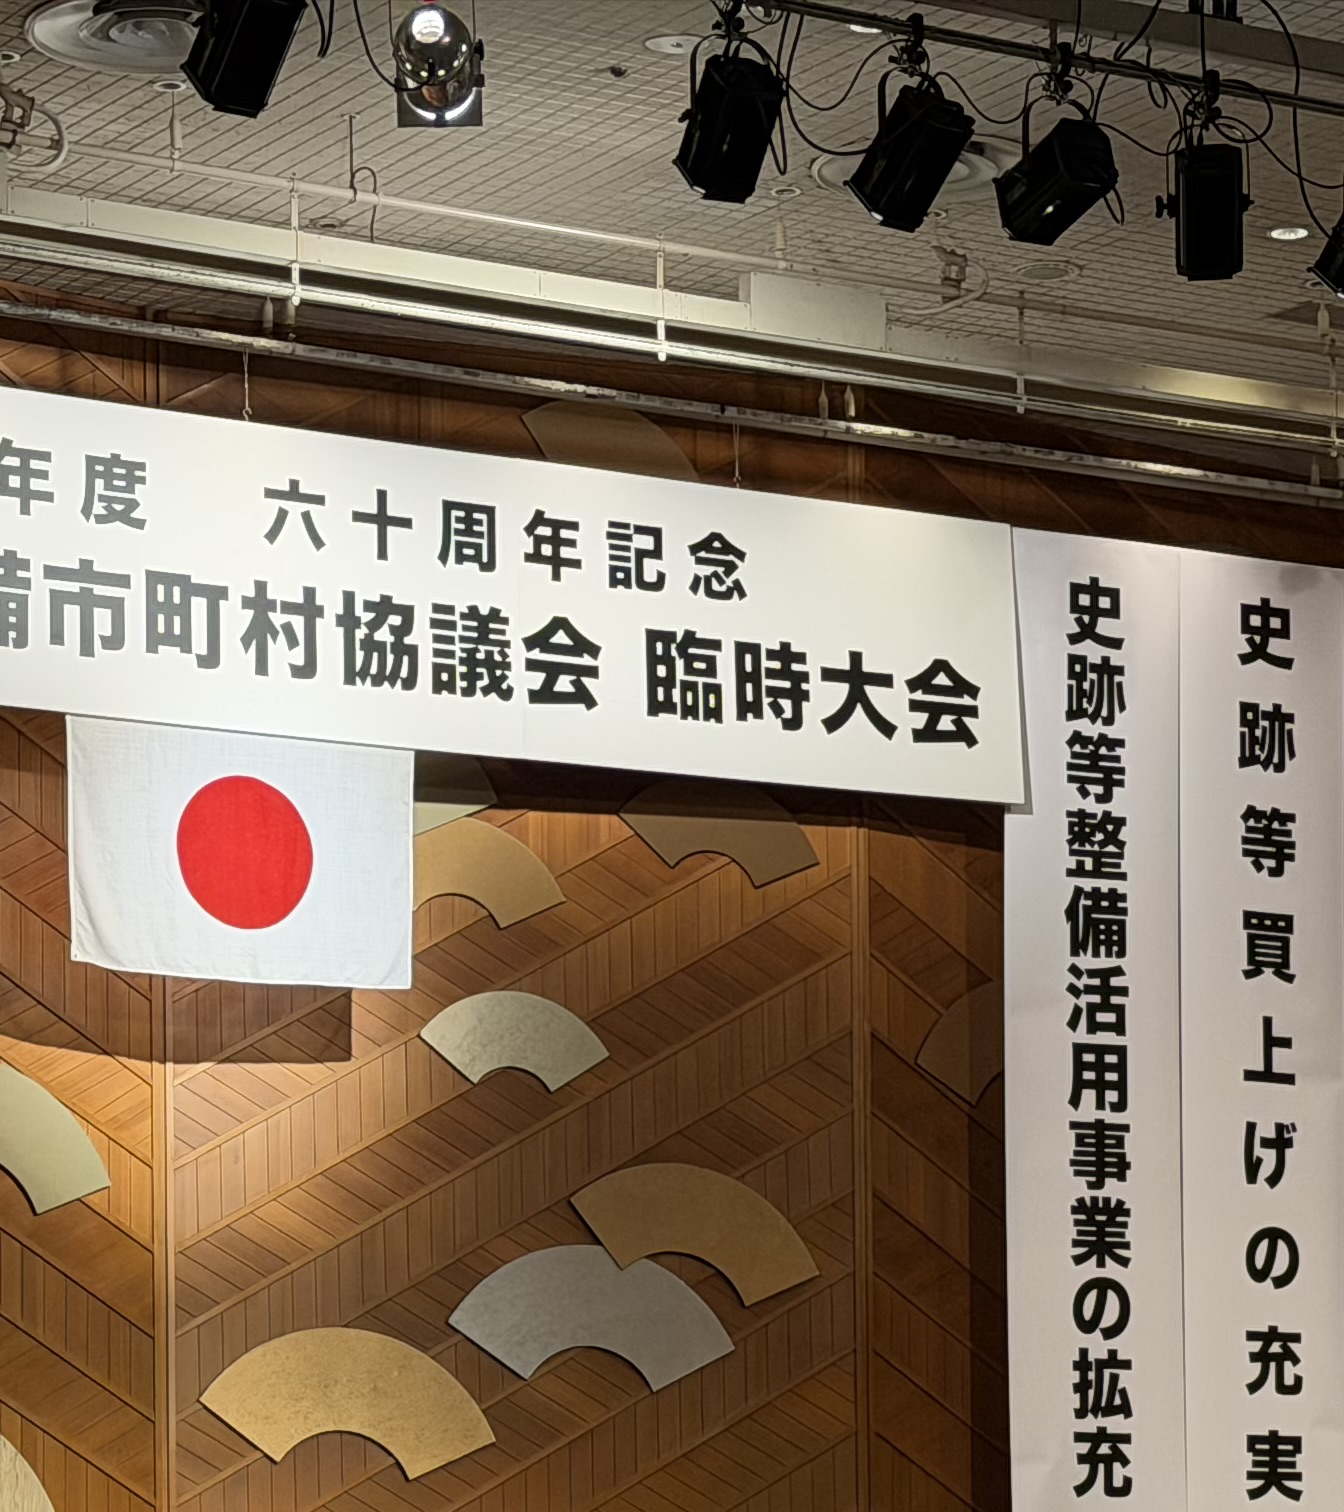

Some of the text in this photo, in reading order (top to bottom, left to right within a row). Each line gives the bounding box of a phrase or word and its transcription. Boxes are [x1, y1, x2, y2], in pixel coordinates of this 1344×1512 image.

[261, 478, 749, 603] 六十周年記念
[644, 628, 982, 750] 臨時大会
[1063, 576, 1135, 1499] 史跡等整備活用事業の拡充
[1236, 596, 1305, 1503] 史跡等買上げの充実
